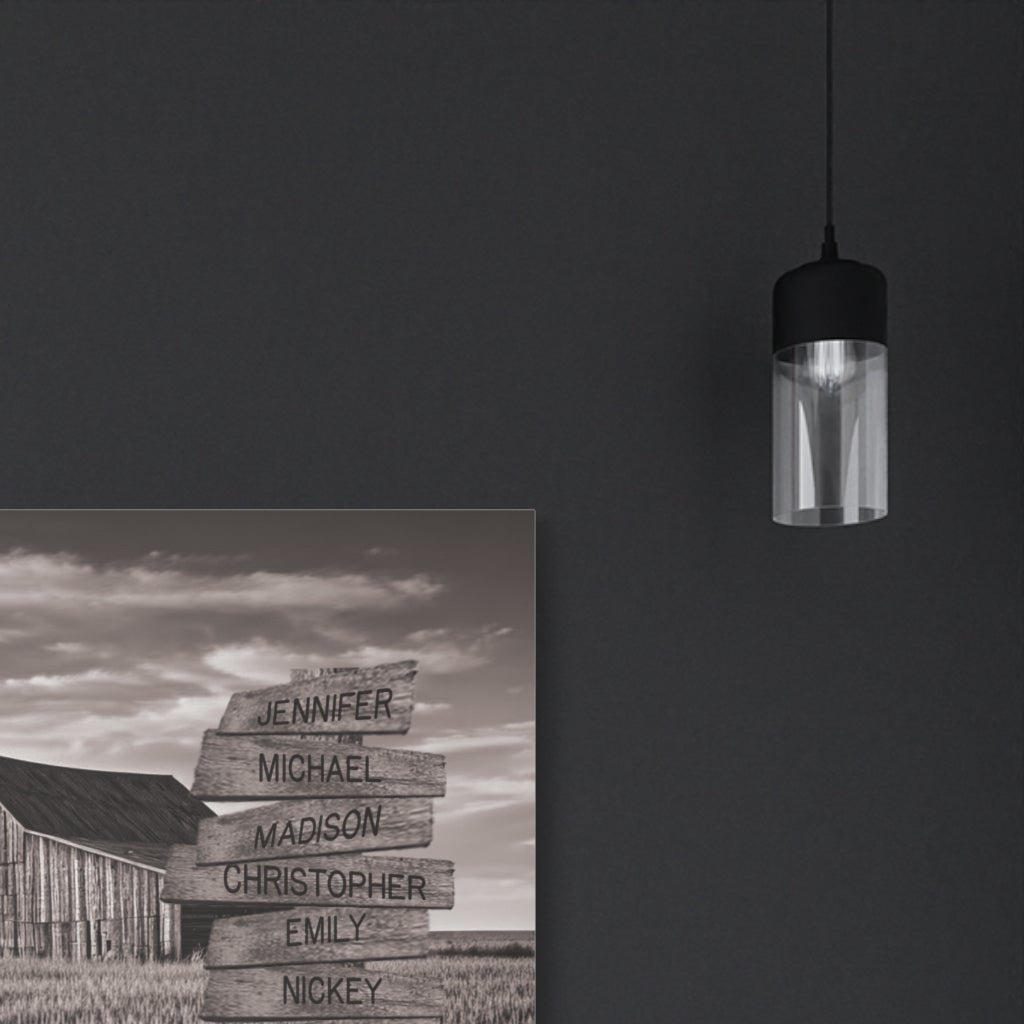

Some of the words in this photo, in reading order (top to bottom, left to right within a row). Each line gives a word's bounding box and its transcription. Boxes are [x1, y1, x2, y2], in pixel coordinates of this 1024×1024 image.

[257, 687, 393, 726] JENNIFER
[258, 753, 382, 783] MICHAEL
[254, 805, 383, 849] MADISON
[223, 864, 427, 900] CHRISTOPHER
[286, 913, 367, 947] EMILY
[282, 975, 383, 1005] NICKEY
